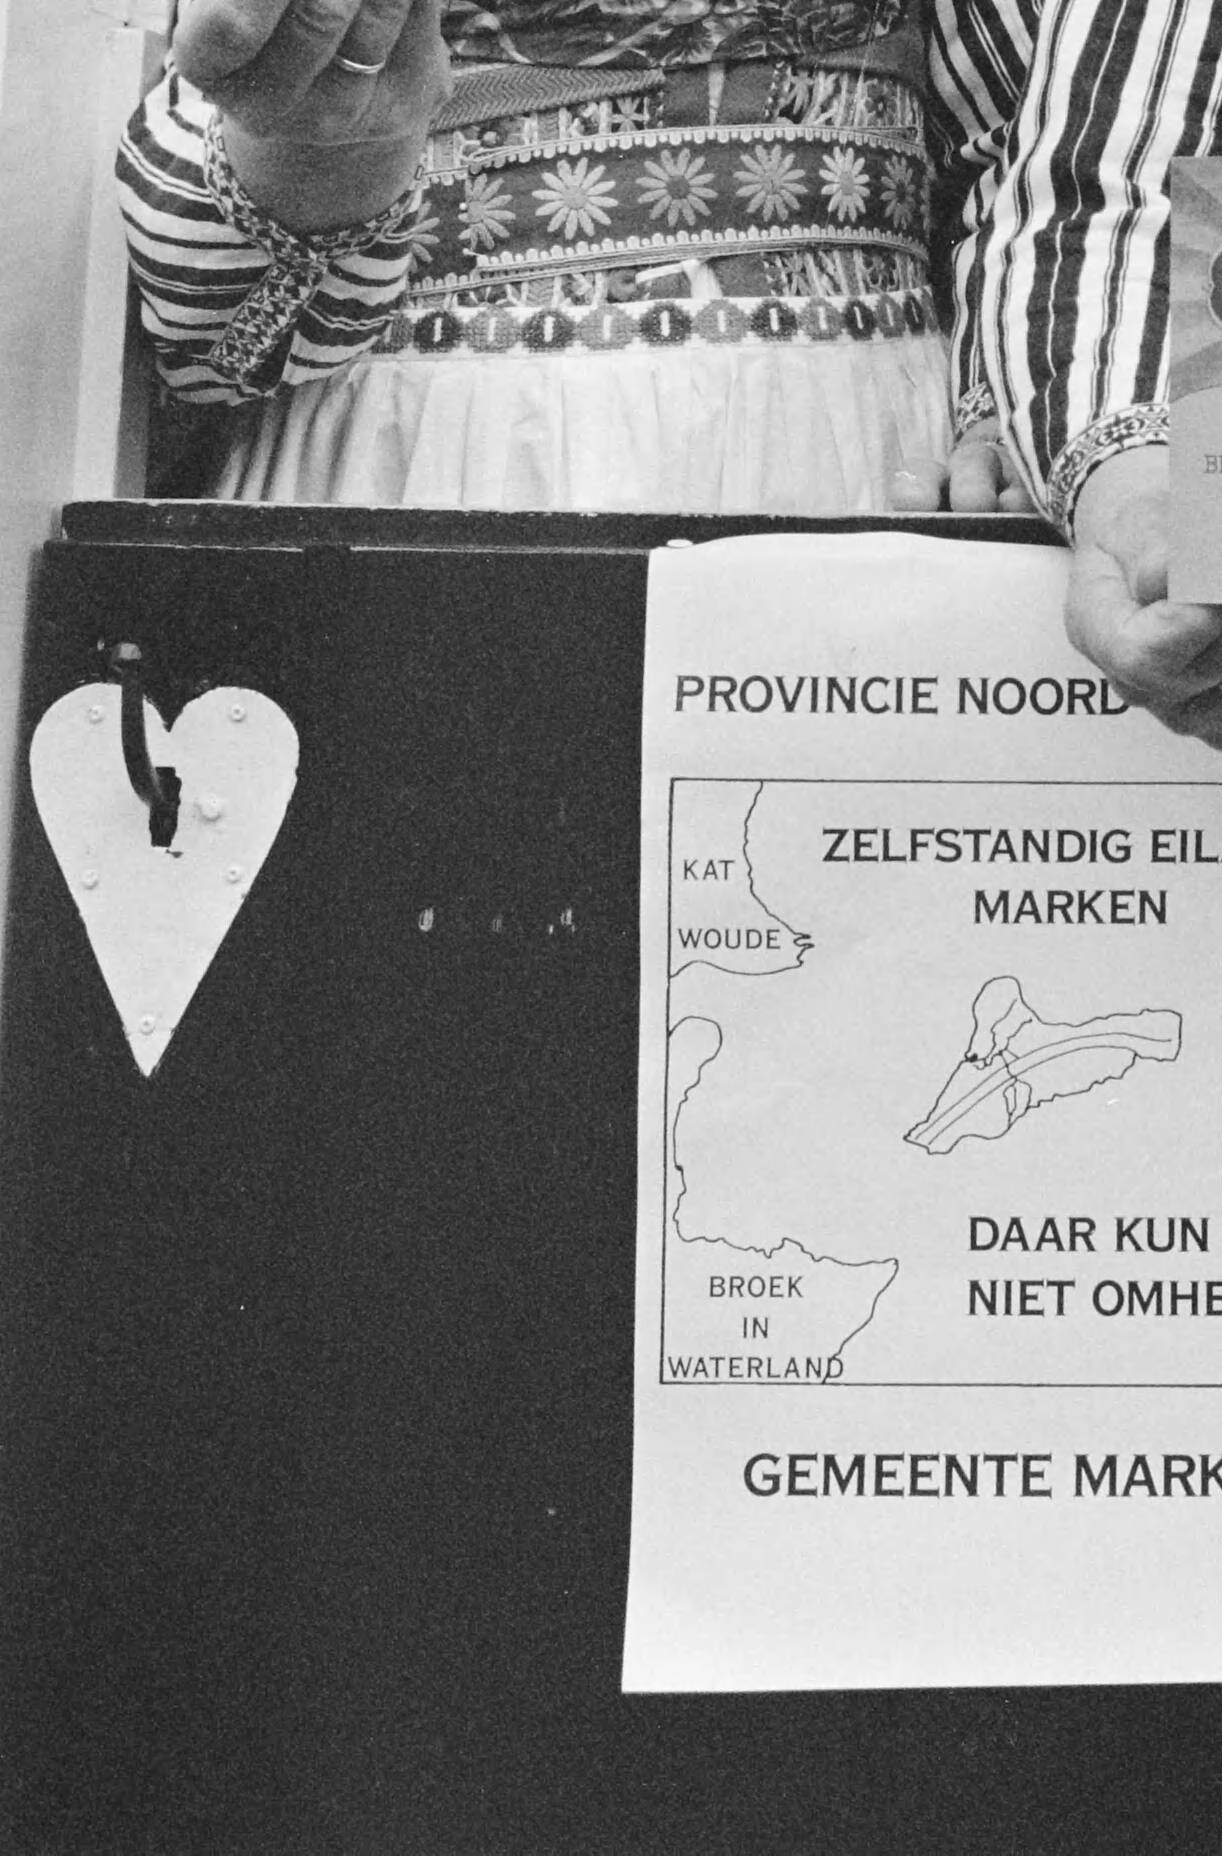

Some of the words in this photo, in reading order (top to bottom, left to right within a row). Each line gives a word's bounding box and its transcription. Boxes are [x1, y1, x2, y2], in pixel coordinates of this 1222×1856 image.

[676, 676, 938, 714] PROVINCIE
[823, 828, 1131, 863] ZELFSTANDIG
[684, 860, 734, 880] KAT
[975, 890, 1166, 924] MARKEN
[679, 929, 780, 949] WOUDE
[970, 1217, 1096, 1251] DAAR
[1117, 1218, 1208, 1252] KUN
[710, 1276, 802, 1297] BROEK
[970, 1280, 1075, 1316] NIET
[744, 1318, 768, 1338] IN
[668, 1357, 843, 1379] WATERLAND
[744, 1453, 1051, 1497] GEMEENTE
